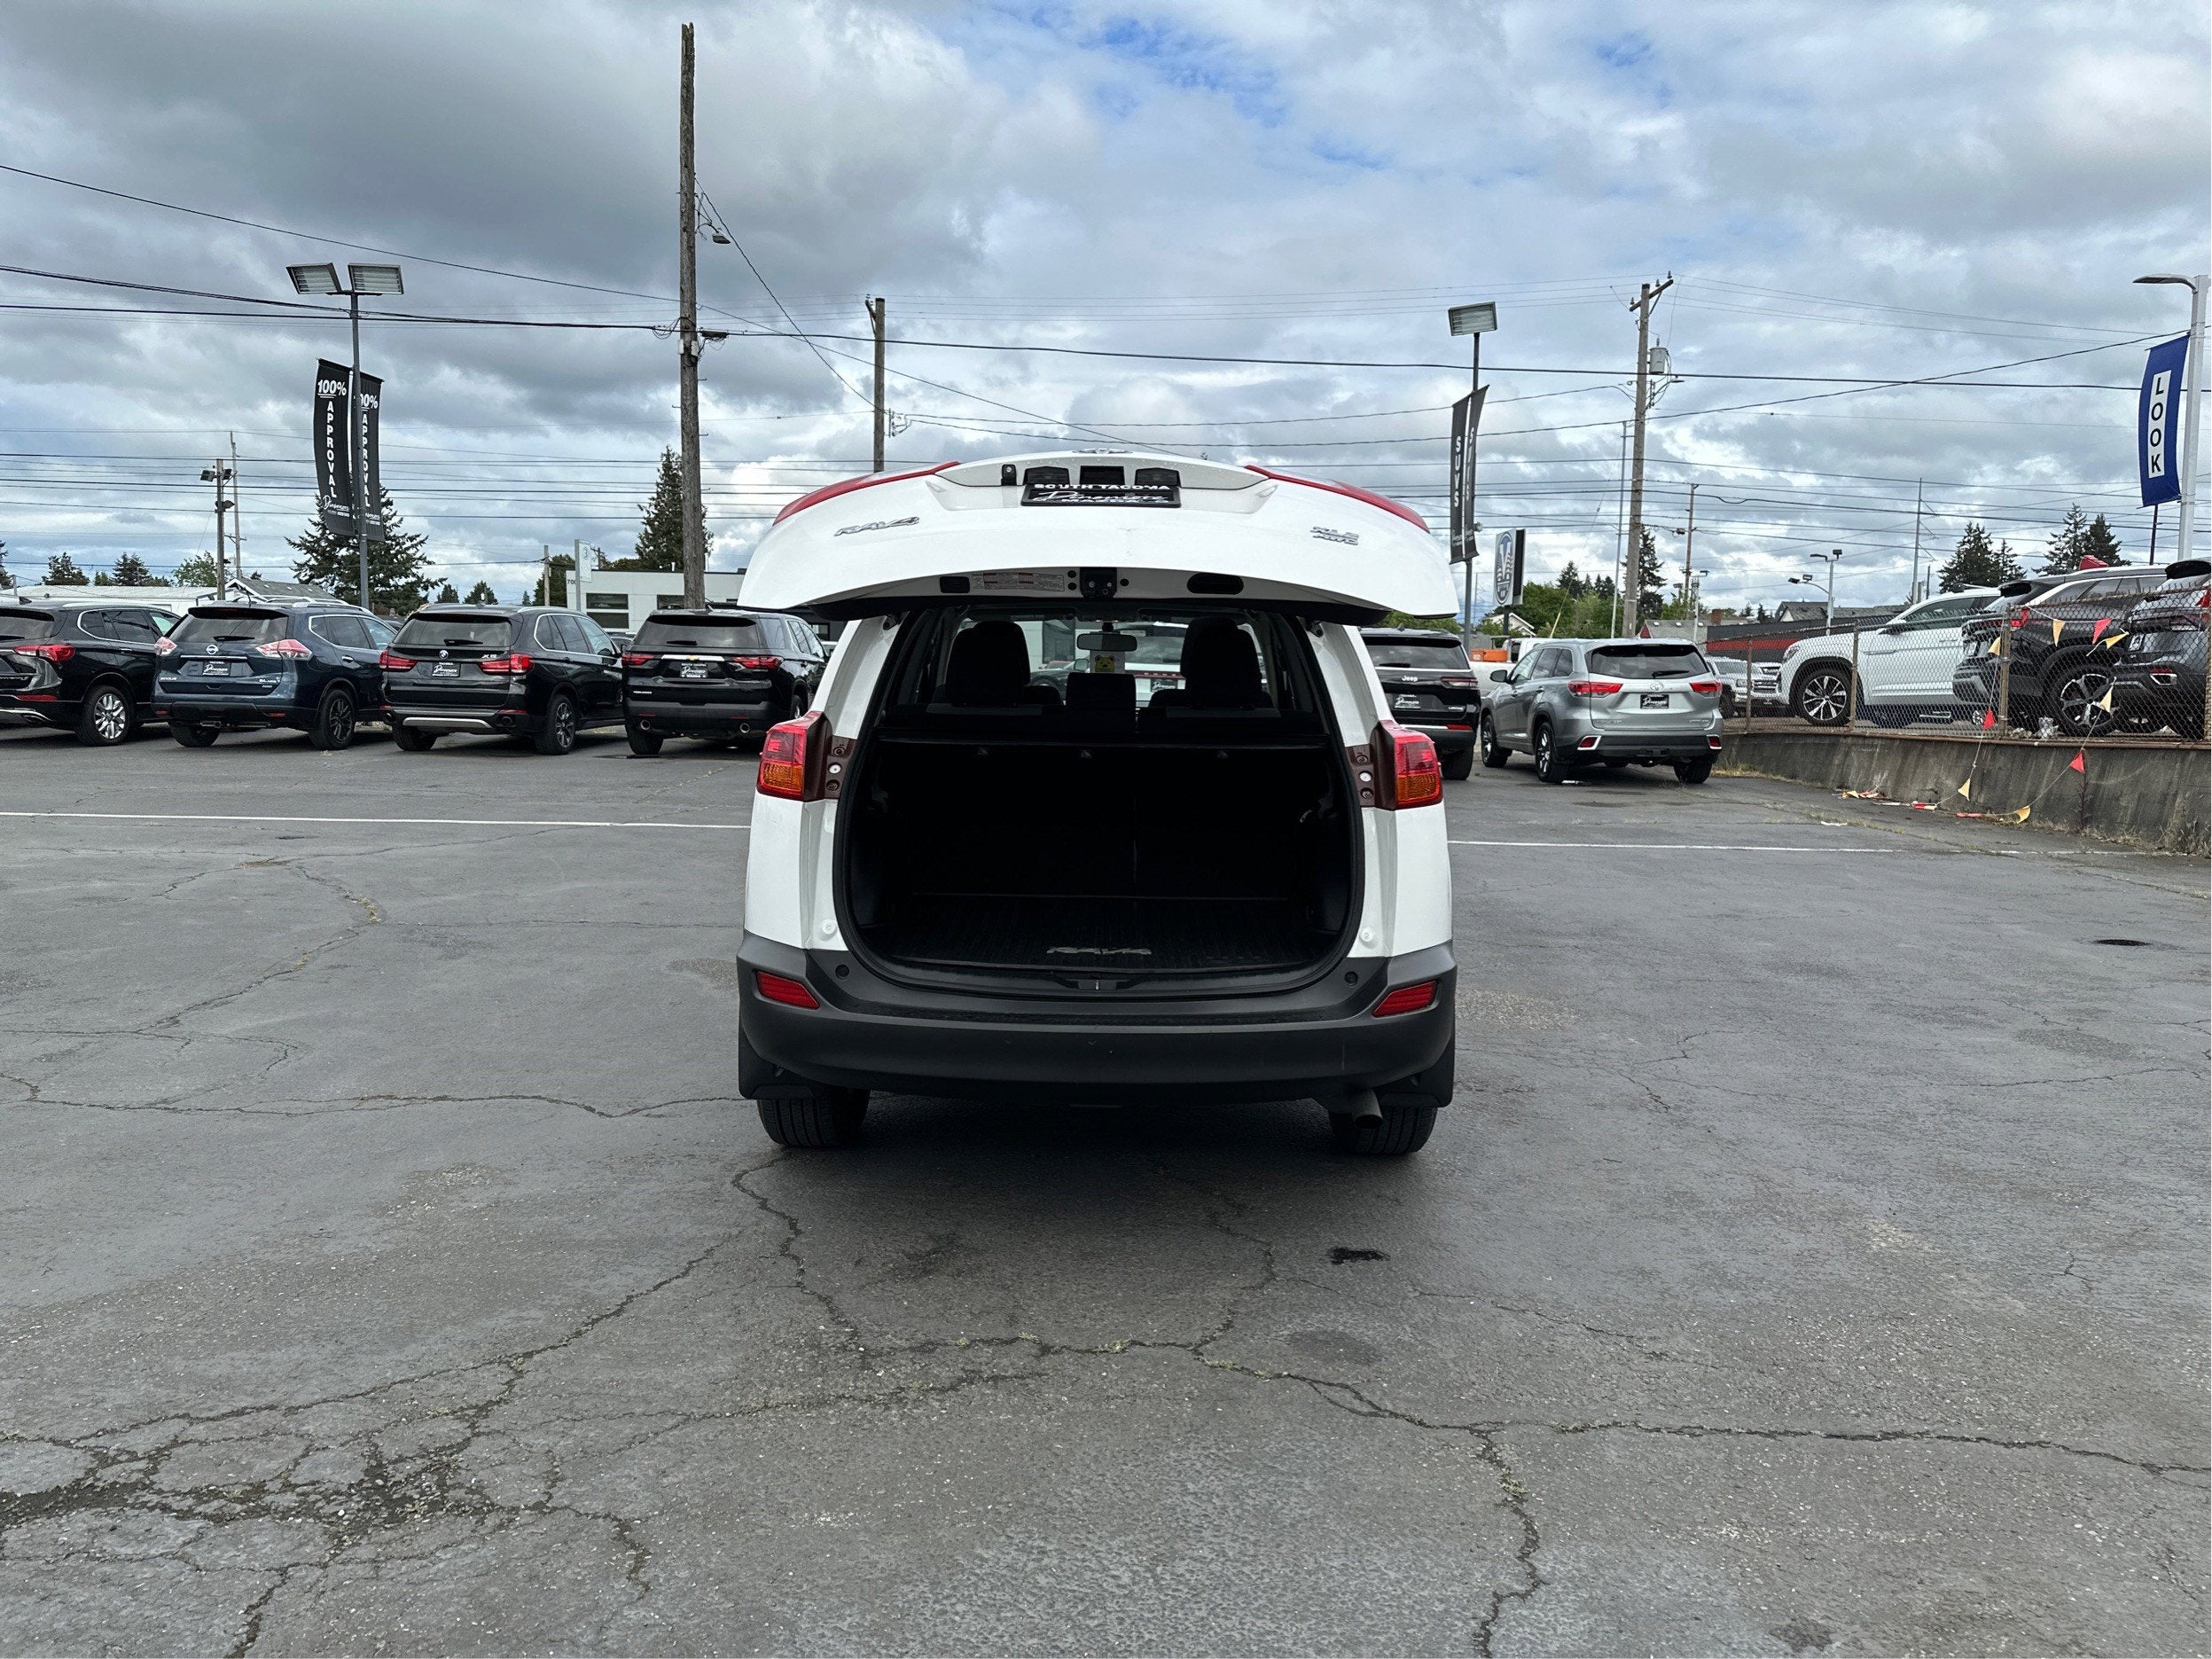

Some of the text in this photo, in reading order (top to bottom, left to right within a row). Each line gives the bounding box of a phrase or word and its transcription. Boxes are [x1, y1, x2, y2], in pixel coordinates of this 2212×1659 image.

[317, 380, 347, 396] 100%
[2150, 377, 2164, 473] LOOK
[326, 401, 337, 498] APPROVAL
